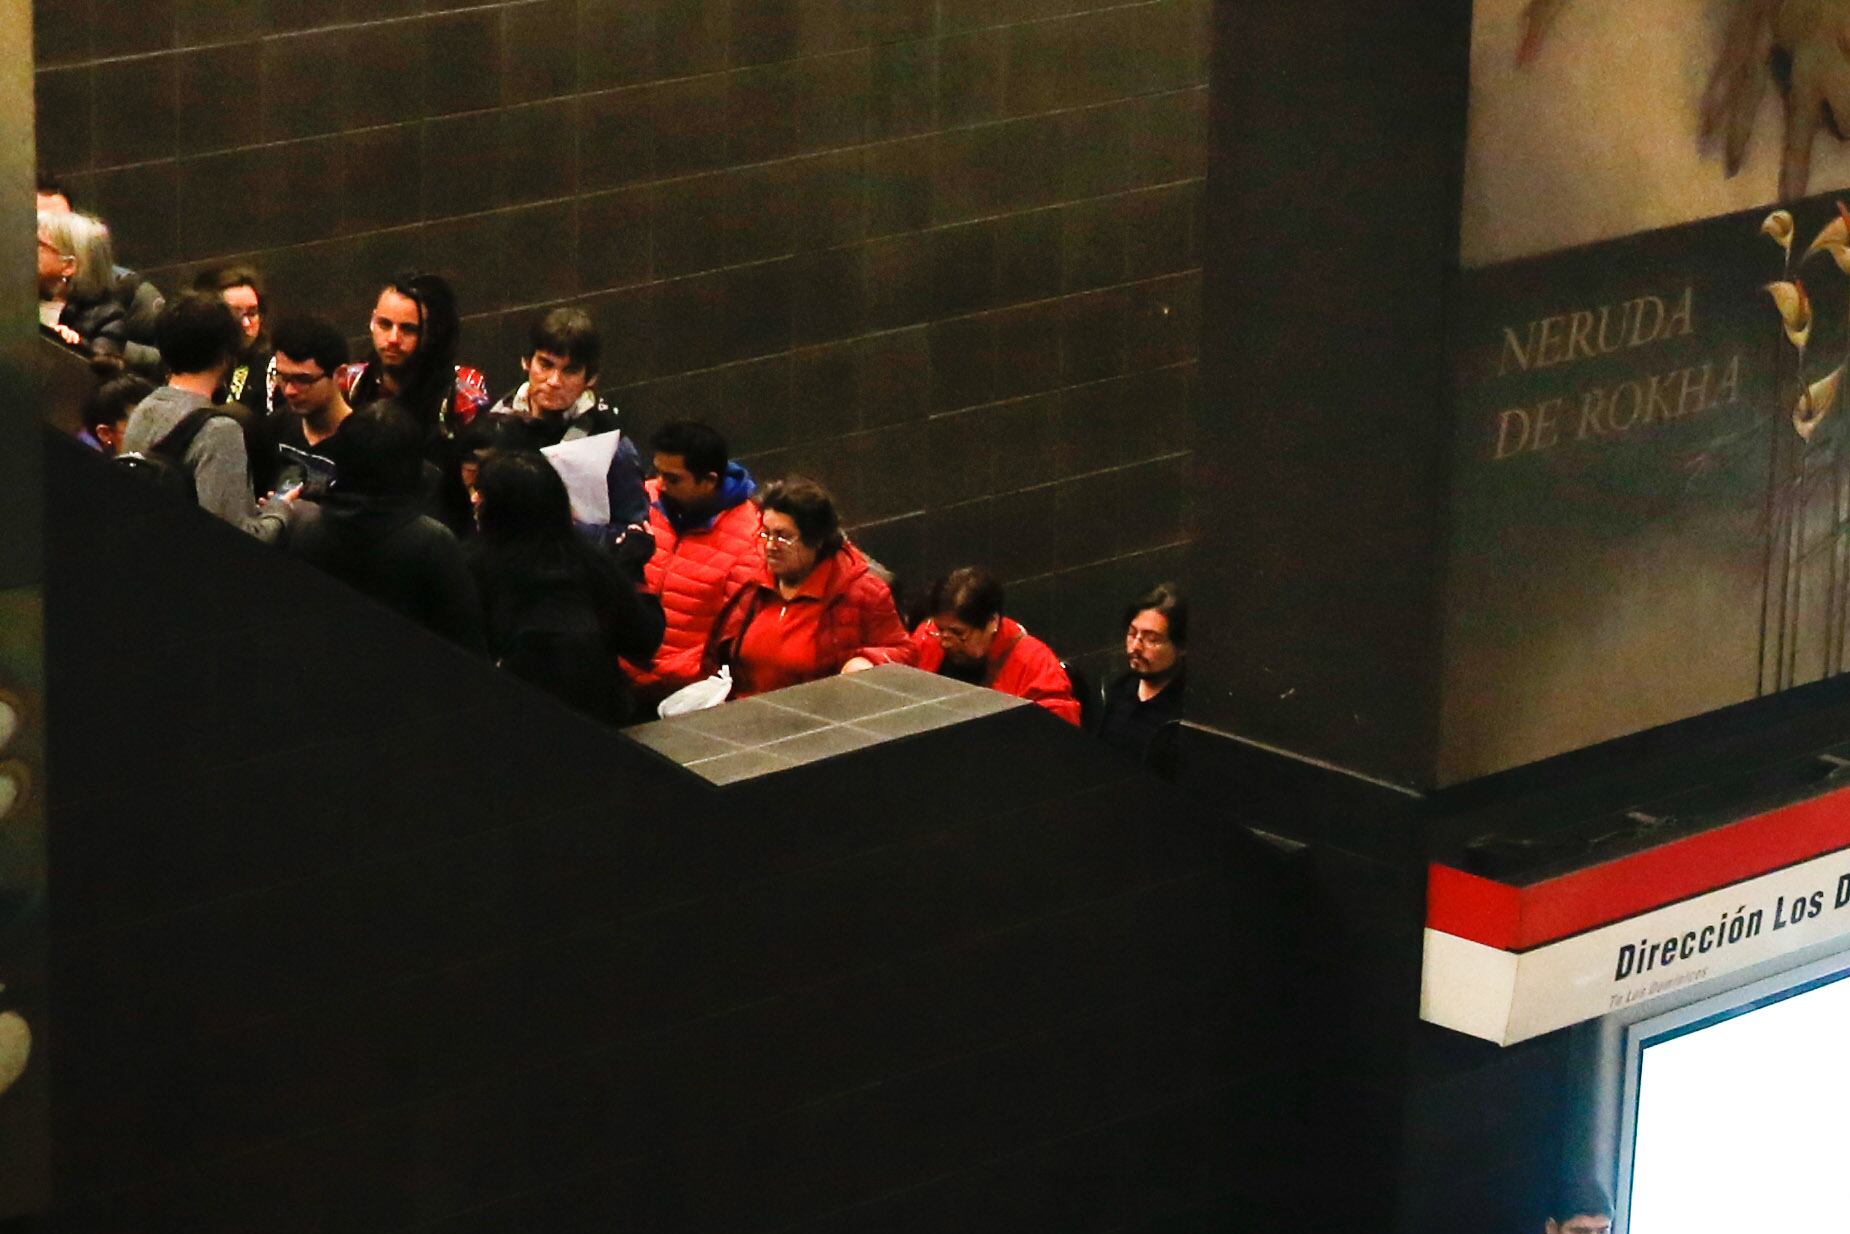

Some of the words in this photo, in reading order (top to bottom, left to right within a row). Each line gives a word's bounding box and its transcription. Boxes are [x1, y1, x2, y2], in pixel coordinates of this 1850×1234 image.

[1498, 286, 1695, 378] NERUDA
[1495, 397, 1563, 459] DE
[1576, 355, 1741, 441] ROKHA
[1614, 904, 1764, 983] Dirección
[1771, 889, 1825, 932] Los
